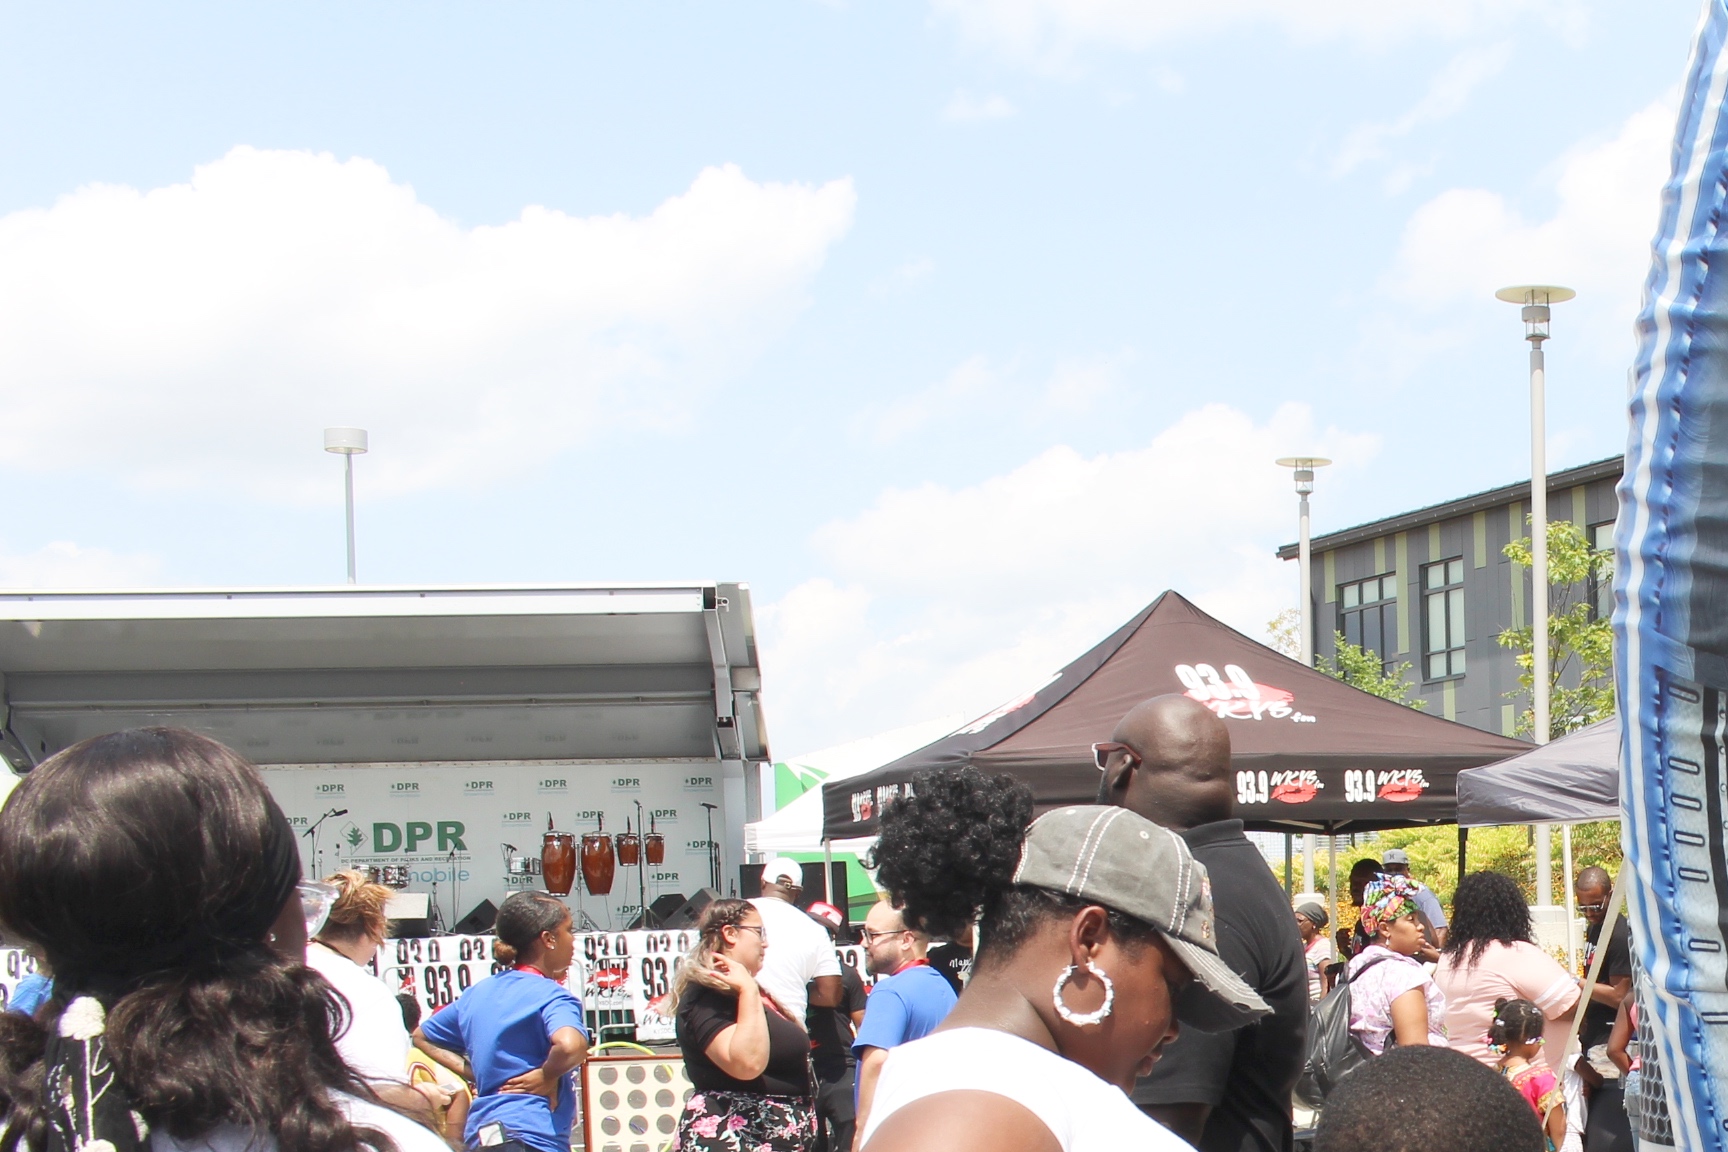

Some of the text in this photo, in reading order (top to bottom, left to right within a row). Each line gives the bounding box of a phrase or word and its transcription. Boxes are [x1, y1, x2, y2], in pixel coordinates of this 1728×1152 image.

[1175, 663, 1260, 701] 93.9
[471, 781, 494, 789] DPR
[545, 780, 567, 788] DPR
[618, 778, 640, 786] DPR
[691, 777, 713, 785] DPR
[322, 784, 345, 792] DPR
[397, 783, 419, 791] DPR
[1236, 770, 1268, 804] 93.9
[1270, 770, 1317, 787] WKYS
[1345, 769, 1375, 803] 93.9
[1378, 769, 1424, 787] WKYS
[509, 812, 531, 820] DPR
[373, 821, 468, 853] DPR
[657, 873, 679, 881] DPR
